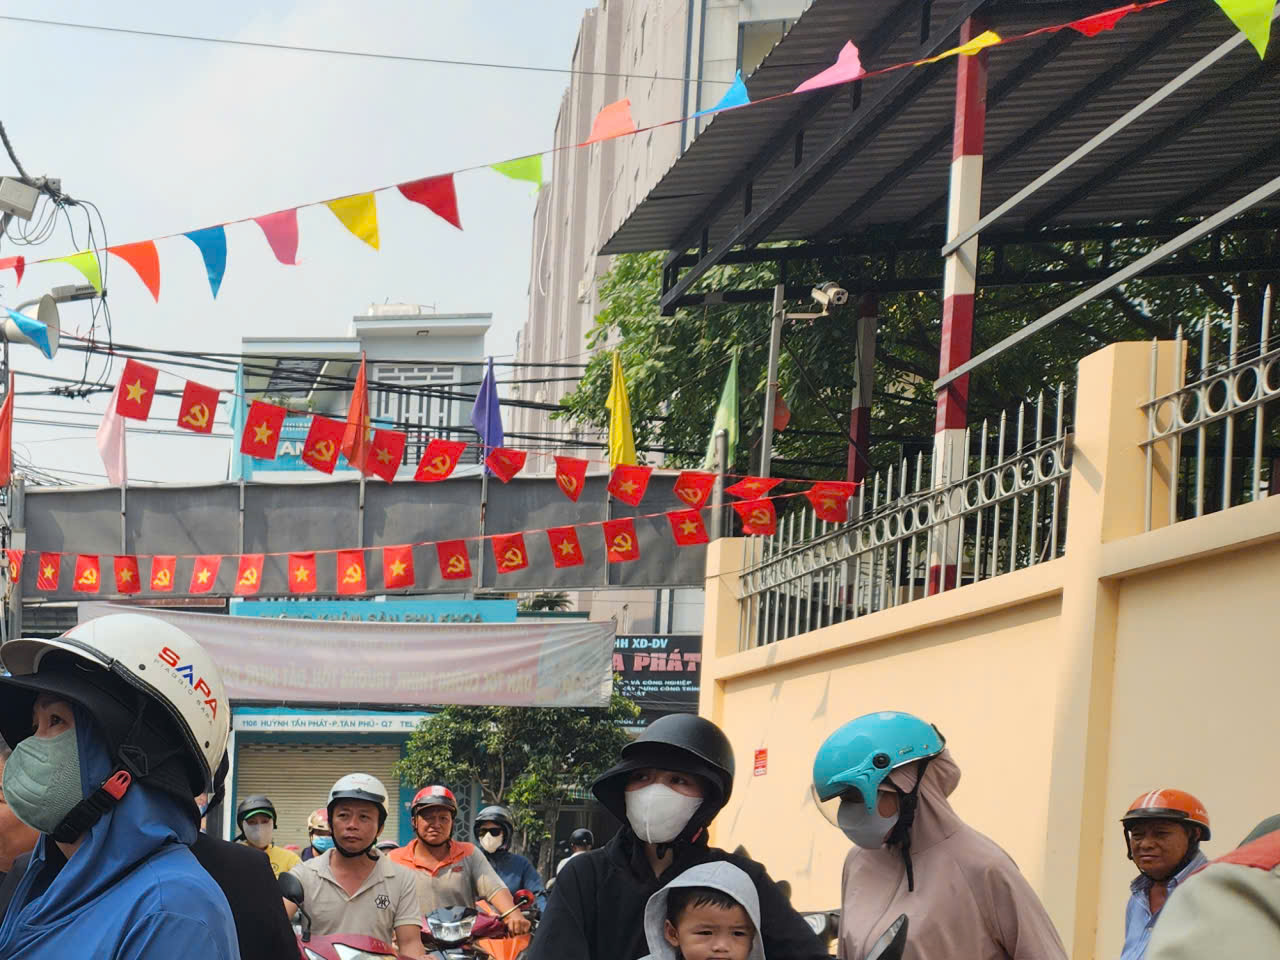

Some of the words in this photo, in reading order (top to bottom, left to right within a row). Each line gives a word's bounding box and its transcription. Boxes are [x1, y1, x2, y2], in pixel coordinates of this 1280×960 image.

[632, 638, 668, 649] XD-DV
[633, 648, 702, 672] PHÁT
[158, 647, 218, 721] SAPA
